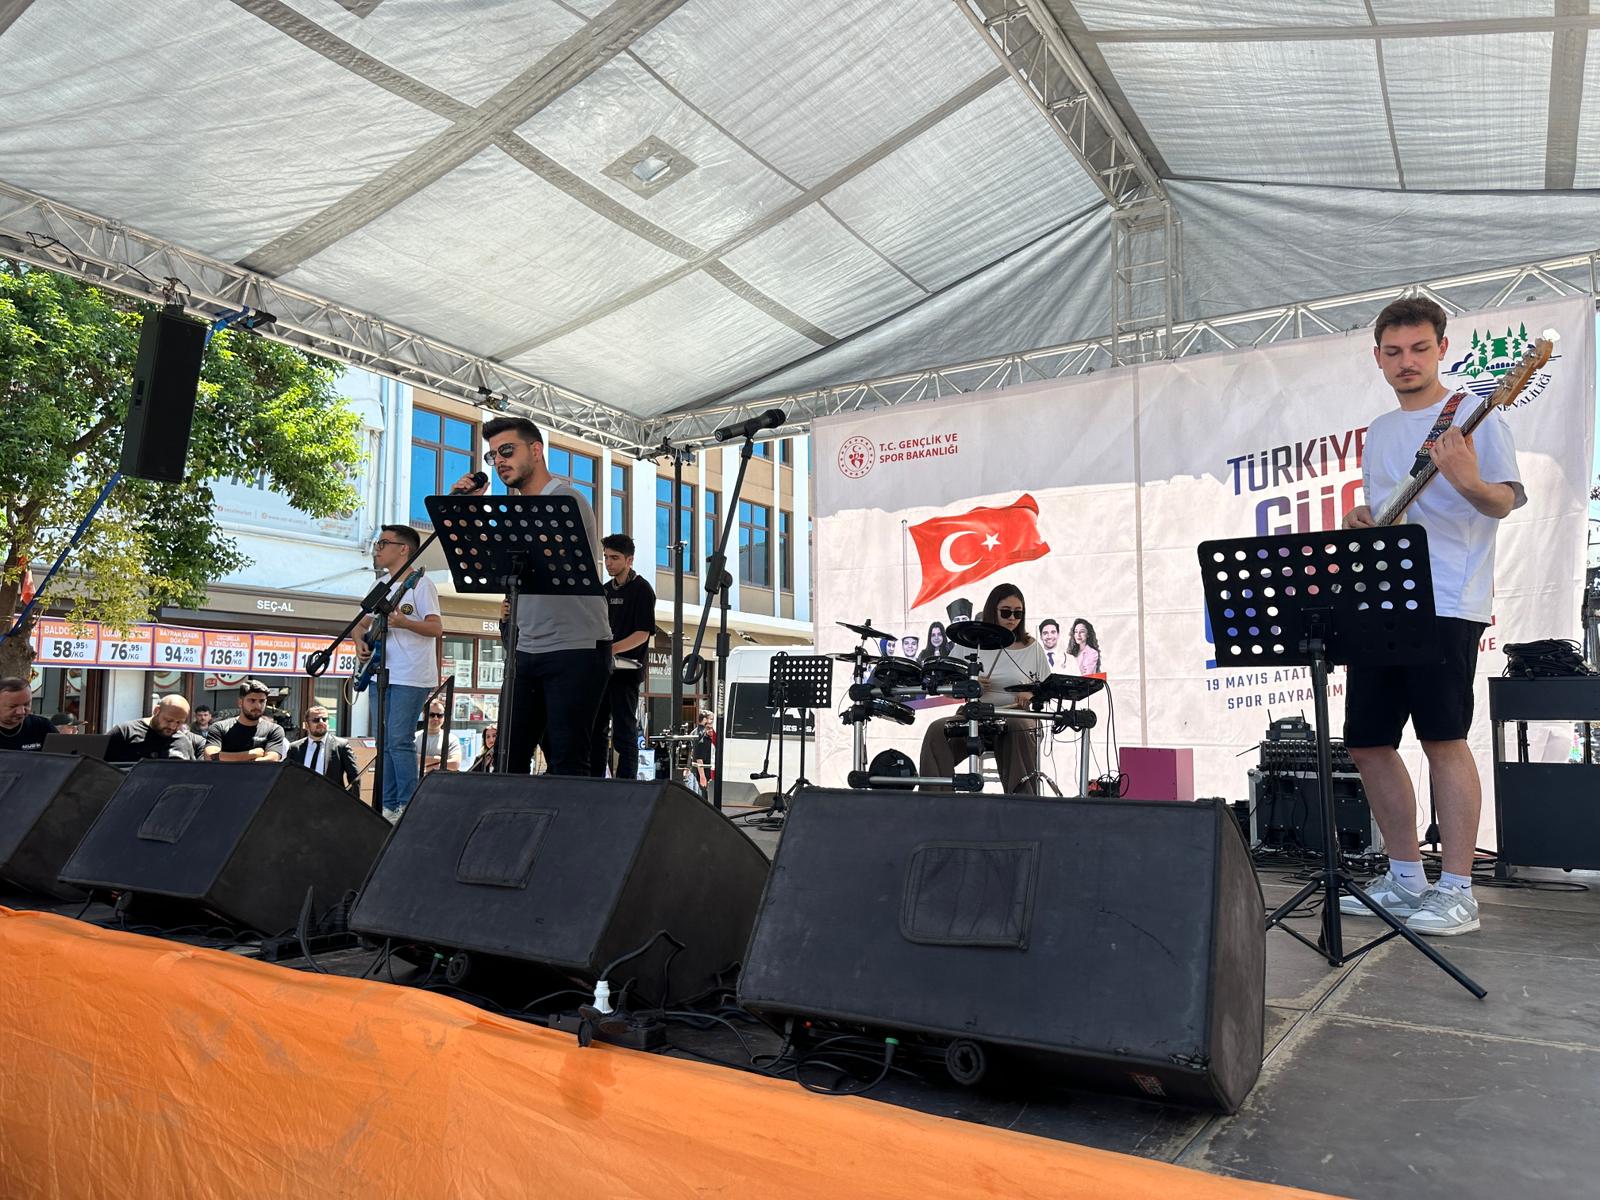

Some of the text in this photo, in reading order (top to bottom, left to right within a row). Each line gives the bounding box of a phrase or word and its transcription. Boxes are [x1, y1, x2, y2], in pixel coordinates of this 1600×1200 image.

[1512, 373, 1552, 408] VALİLİĞİ
[879, 433, 958, 452] T.C. GENÇLİK VE
[879, 444, 958, 464] SPOR BAKANLIĞI
[256, 599, 294, 613] SEÇ-AL
[53, 640, 73, 658] 58
[111, 643, 128, 660] 76
[165, 645, 182, 662] 94
[210, 648, 232, 665] 136
[258, 651, 278, 667] 179
[1206, 679, 1220, 691] 19
[1226, 672, 1268, 689] MAYIS
[1227, 694, 1262, 709] SPOR
